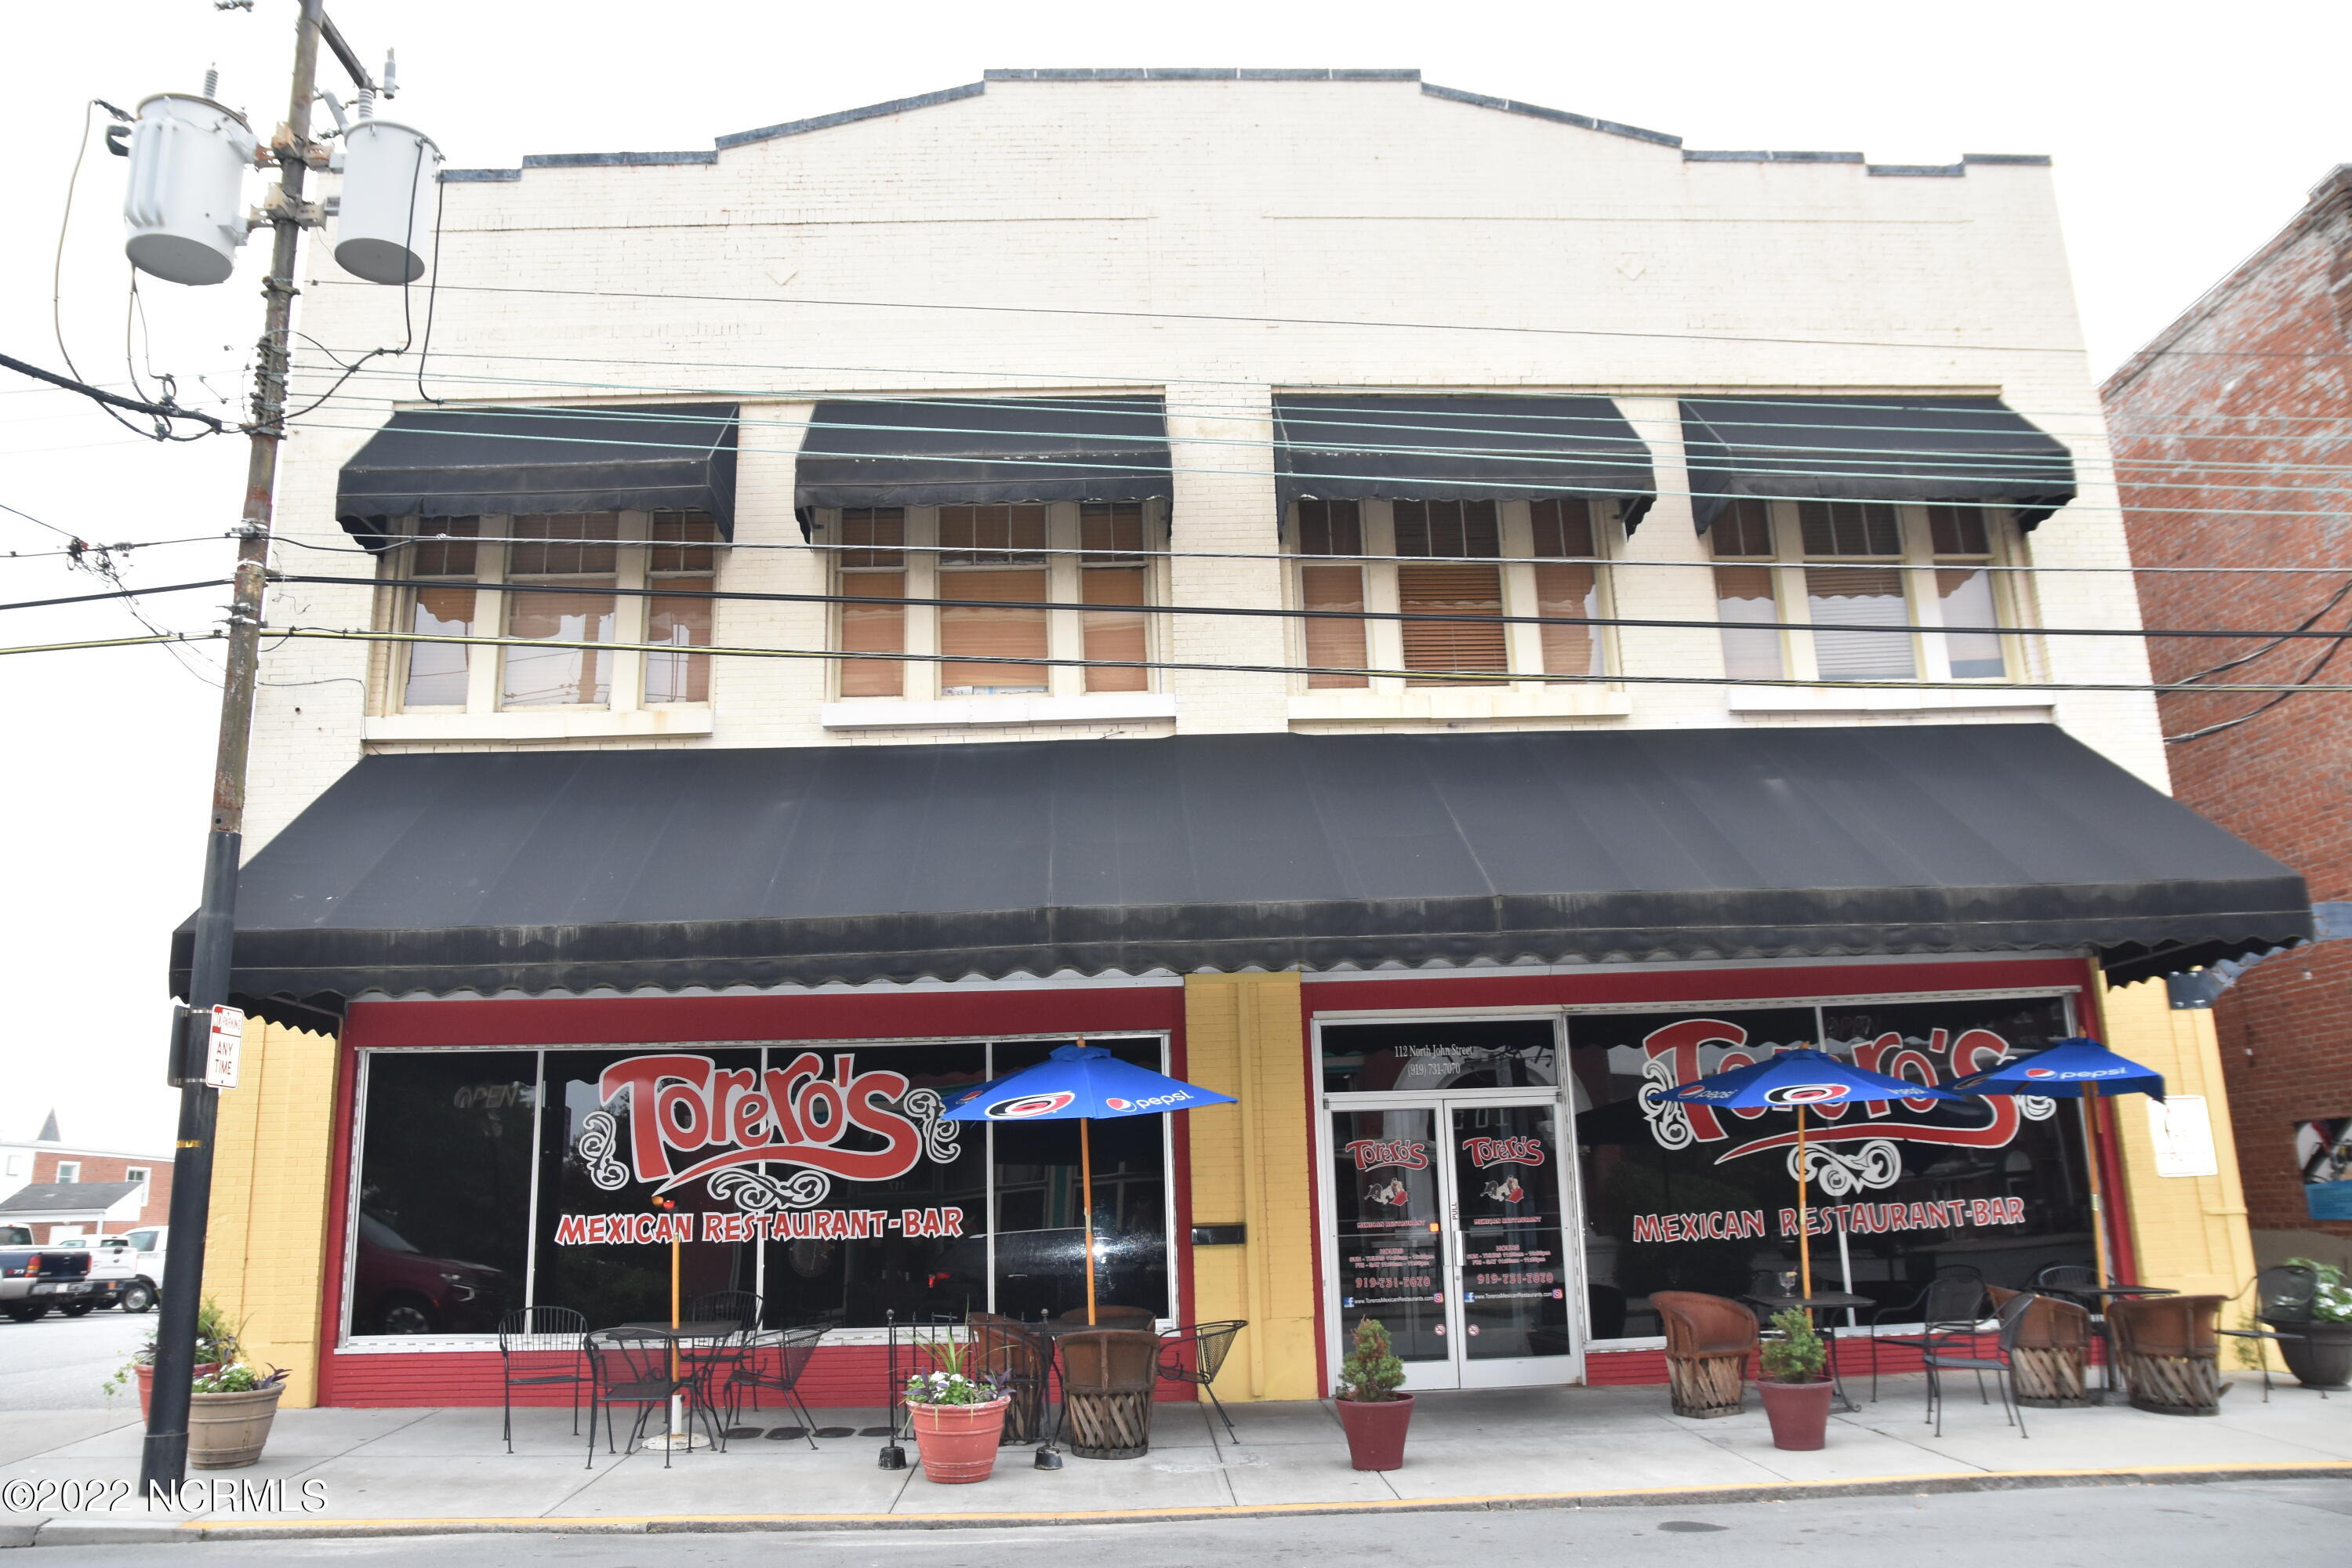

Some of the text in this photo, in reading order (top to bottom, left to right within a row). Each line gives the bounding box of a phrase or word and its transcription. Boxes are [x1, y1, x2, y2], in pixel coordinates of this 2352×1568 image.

[223, 1015, 241, 1030] PARKING
[217, 1040, 234, 1057] ANY
[1394, 1044, 1473, 1059] 112 North John Street
[215, 1059, 232, 1075] TIME
[1407, 1062, 1461, 1077] (919) 731-7070
[2060, 1067, 2128, 1080] pepsi
[1136, 1090, 1192, 1109] pepsi
[554, 1213, 693, 1245] MEXICAN
[1633, 1210, 1765, 1243] MEXICAN
[1355, 1276, 1431, 1289] 919-731-7070
